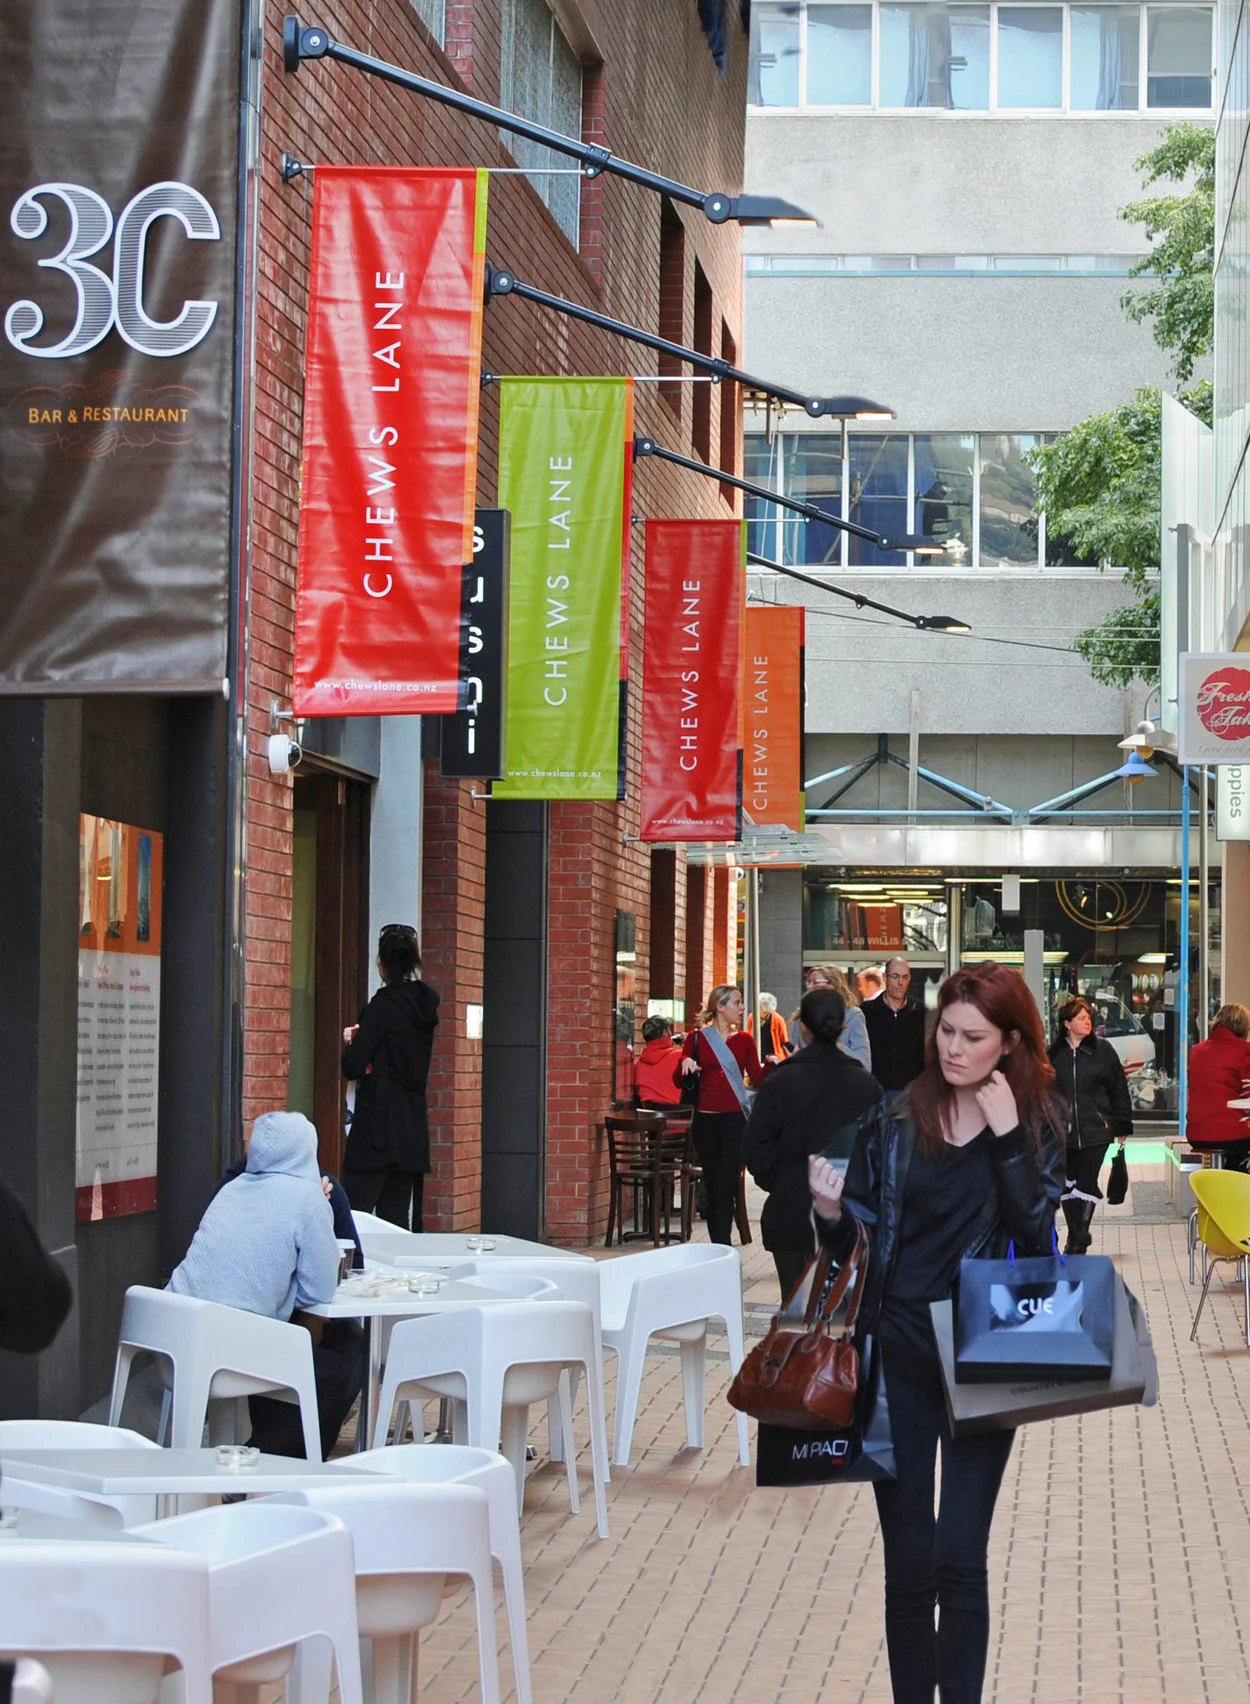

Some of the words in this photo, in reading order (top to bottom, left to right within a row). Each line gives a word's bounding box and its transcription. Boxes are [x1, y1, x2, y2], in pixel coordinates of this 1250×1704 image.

[5, 181, 221, 358] 3C
[371, 271, 404, 392] LANE
[29, 408, 62, 424] BAR
[68, 410, 79, 424] &
[83, 407, 189, 422] RESTAURANT
[363, 425, 398, 598] CHEWS
[548, 457, 572, 549] LANE
[544, 574, 569, 706] CHEWS
[682, 580, 701, 651] LANE
[314, 680, 437, 692] www.chewslane.co.nz
[680, 671, 699, 770] CHEWS
[753, 656, 769, 714] LANE
[508, 768, 602, 778] www.chewslane.co.nz
[753, 729, 768, 811] CHEWS
[1227, 764, 1246, 818] ppies
[1017, 1297, 1054, 1316] CUE
